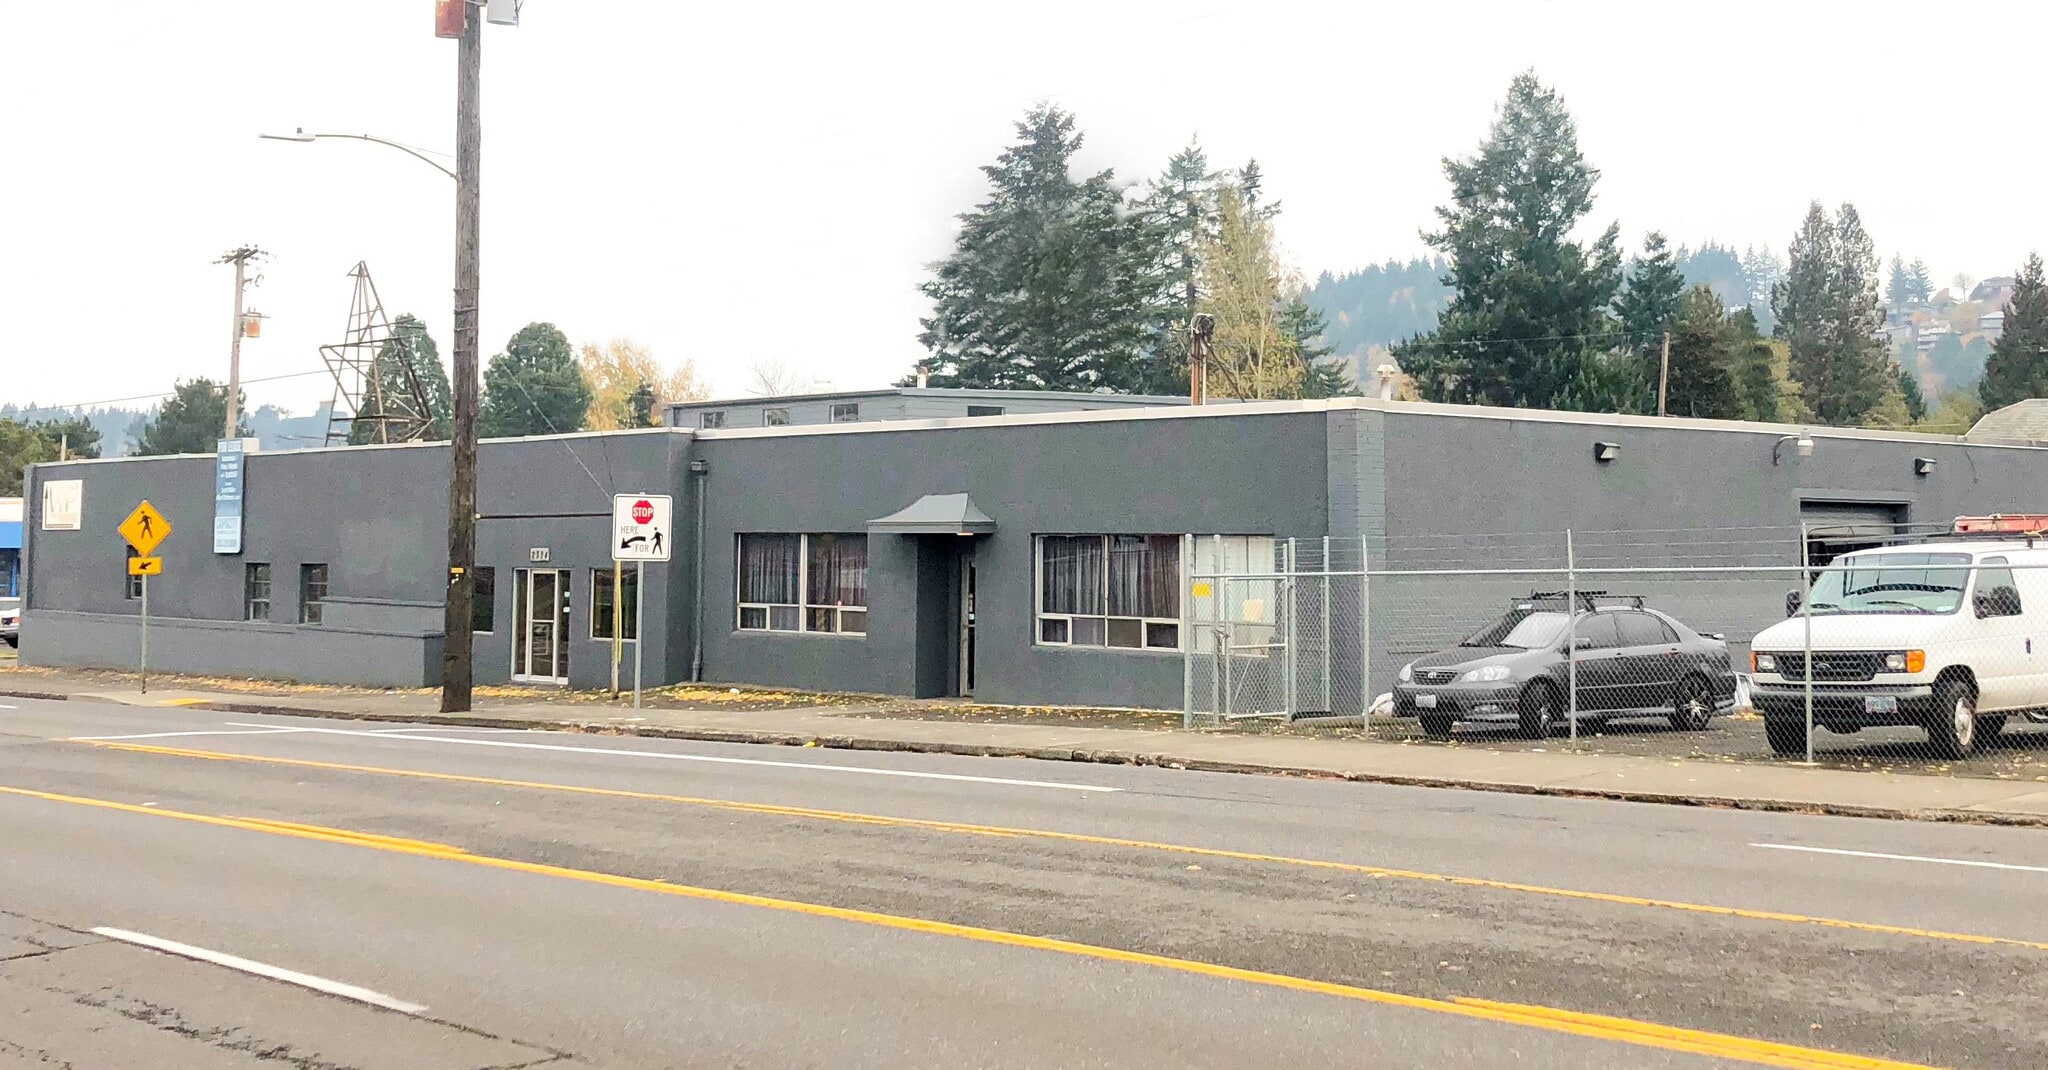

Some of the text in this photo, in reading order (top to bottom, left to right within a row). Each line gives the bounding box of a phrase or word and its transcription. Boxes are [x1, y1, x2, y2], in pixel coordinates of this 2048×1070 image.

[632, 507, 654, 518] STOP
[620, 525, 639, 534] HERE
[635, 544, 649, 553] FOR
